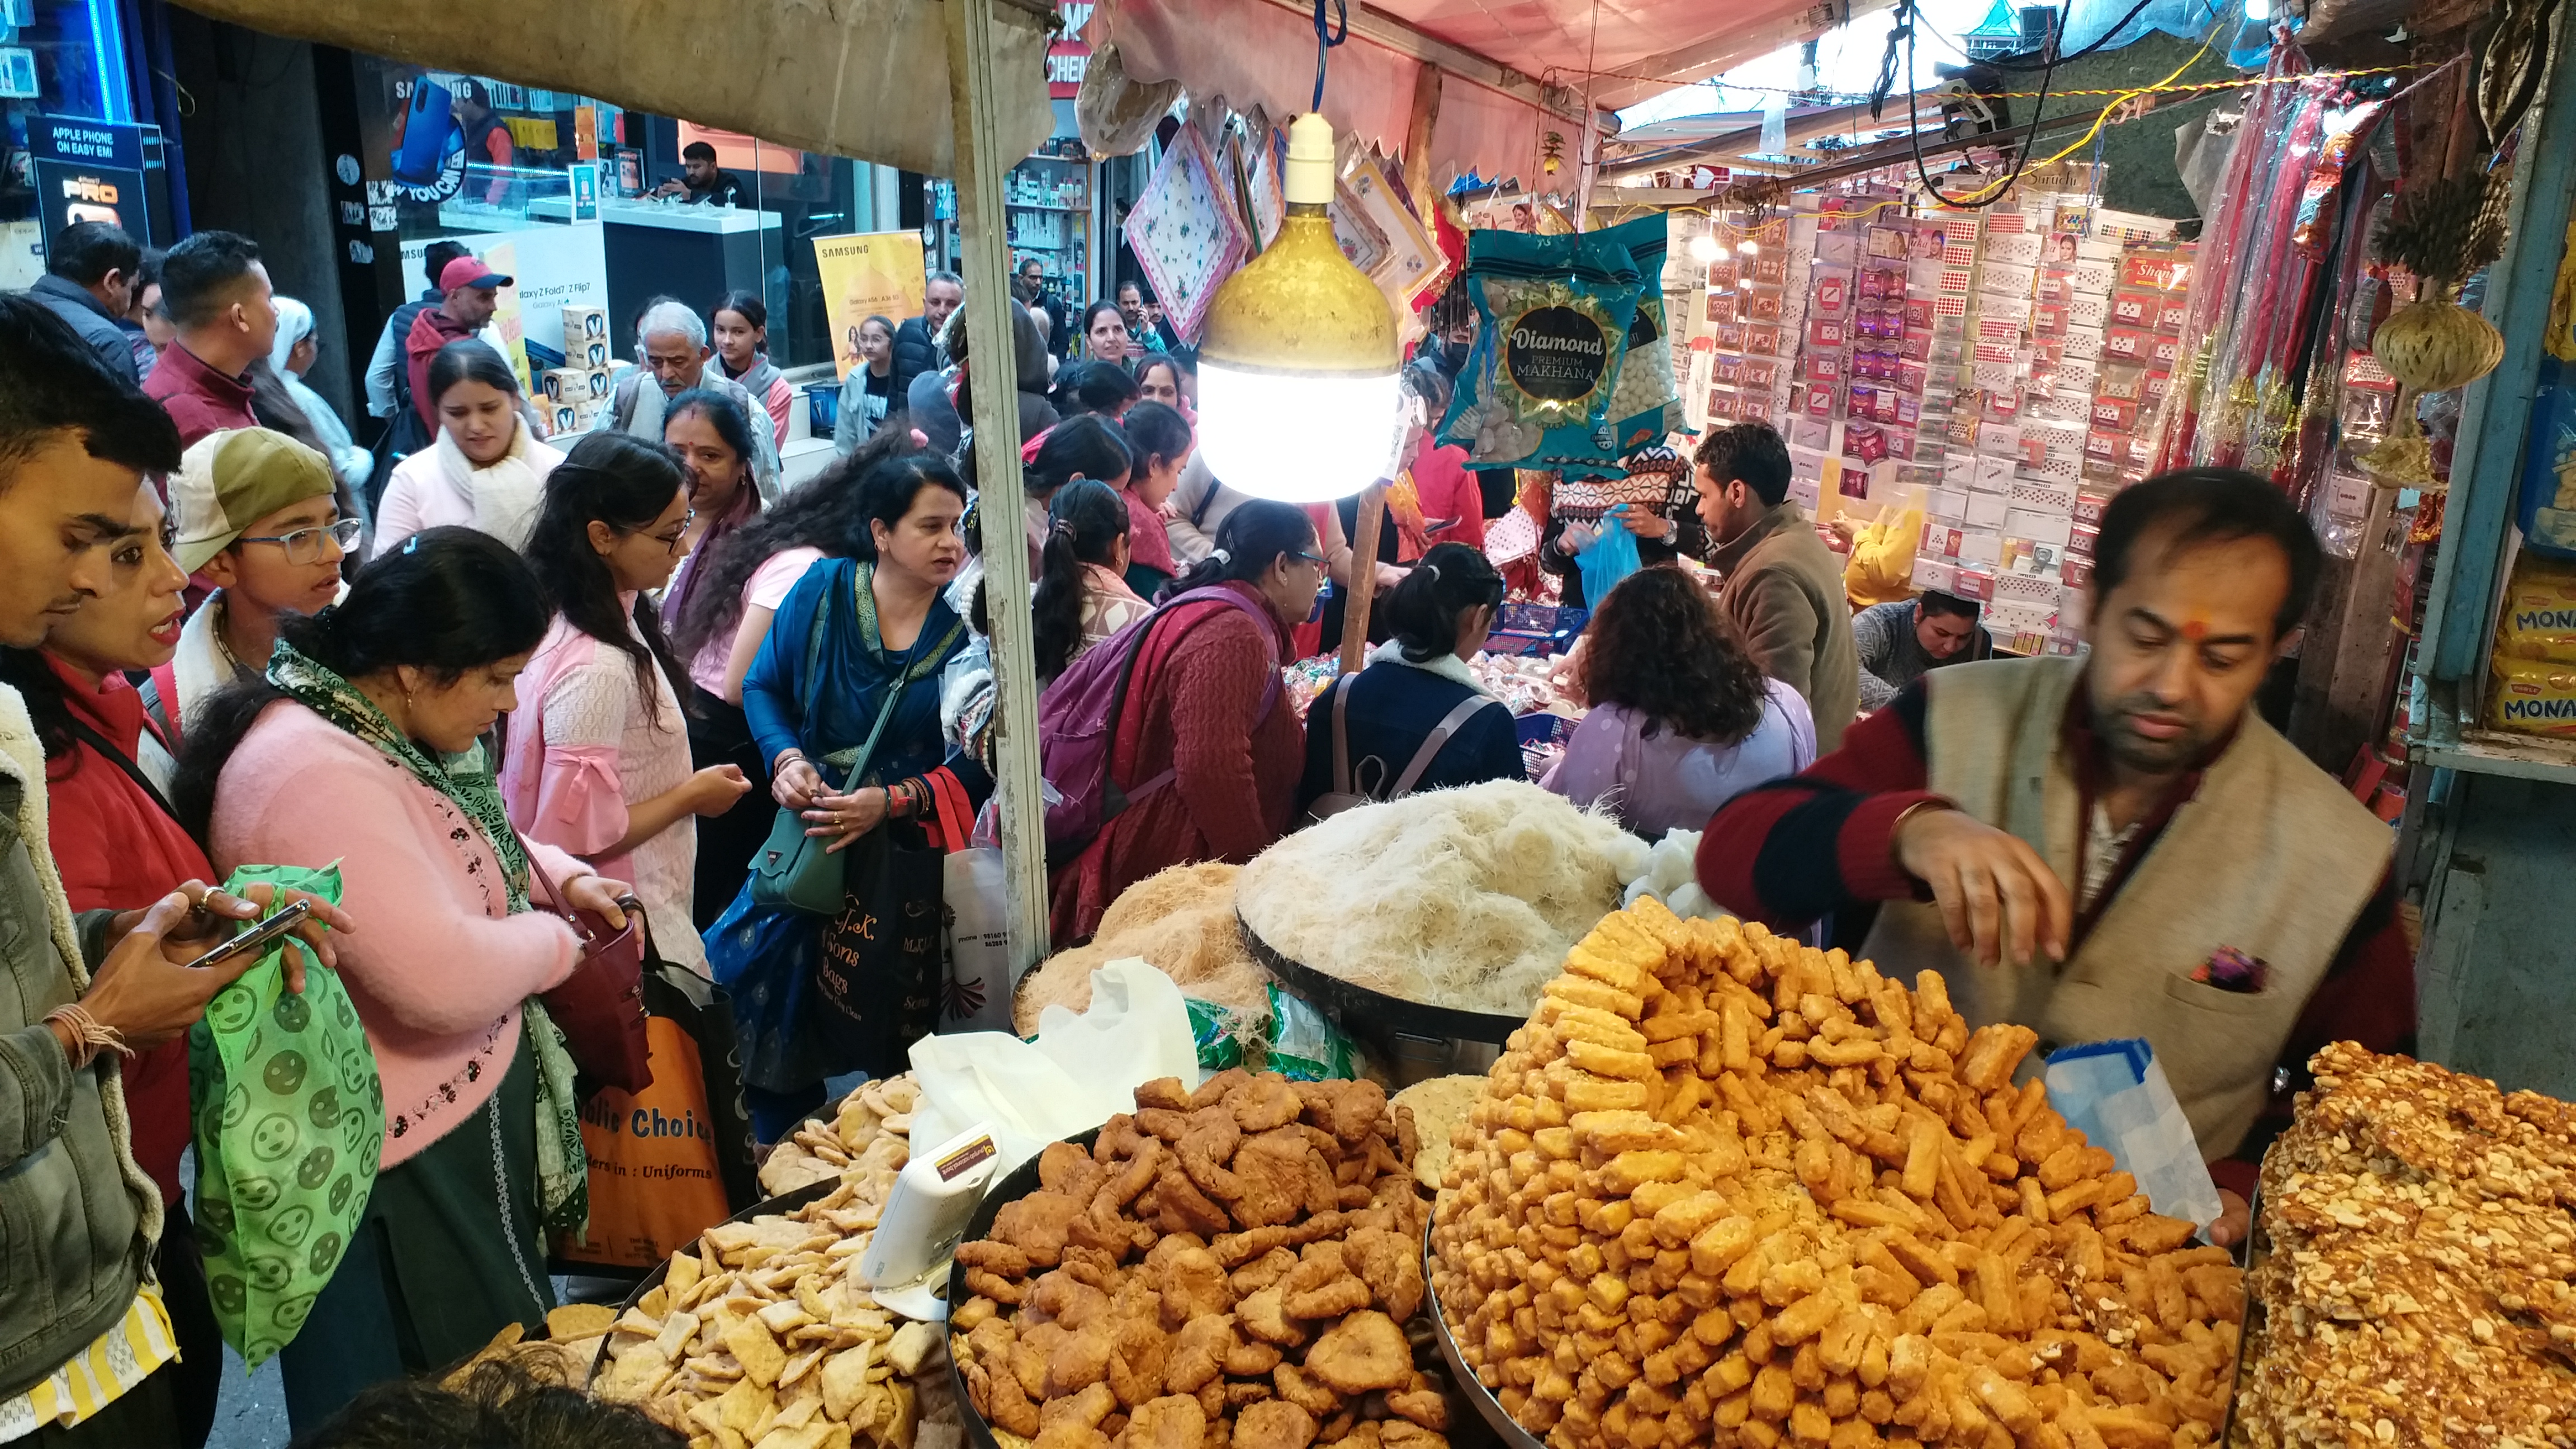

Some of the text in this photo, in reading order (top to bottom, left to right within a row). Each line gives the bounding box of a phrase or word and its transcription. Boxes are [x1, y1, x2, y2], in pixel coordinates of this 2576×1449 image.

[395, 80, 472, 99] SANG
[53, 127, 114, 145] APPLE PHONE
[57, 141, 113, 159] ON EASY EMI
[63, 179, 119, 204] PRO
[408, 184, 442, 202] YOU
[437, 169, 462, 195] CAN
[822, 244, 869, 258] SAMSUNG
[519, 282, 590, 300] laxy Z Fold7 Z Flip7
[533, 300, 556, 309] Galaxy
[1510, 327, 1603, 356] Diamond
[1531, 354, 1583, 367] PREMIUM
[1517, 364, 1594, 381] MAKHANA
[2505, 699, 2576, 720] MONA
[958, 935, 978, 944] Phone
[827, 931, 860, 968] Sons
[822, 955, 849, 997] Bags
[586, 1153, 610, 1171] ders
[614, 1162, 626, 1177] in
[643, 1164, 712, 1181] Uniforms
